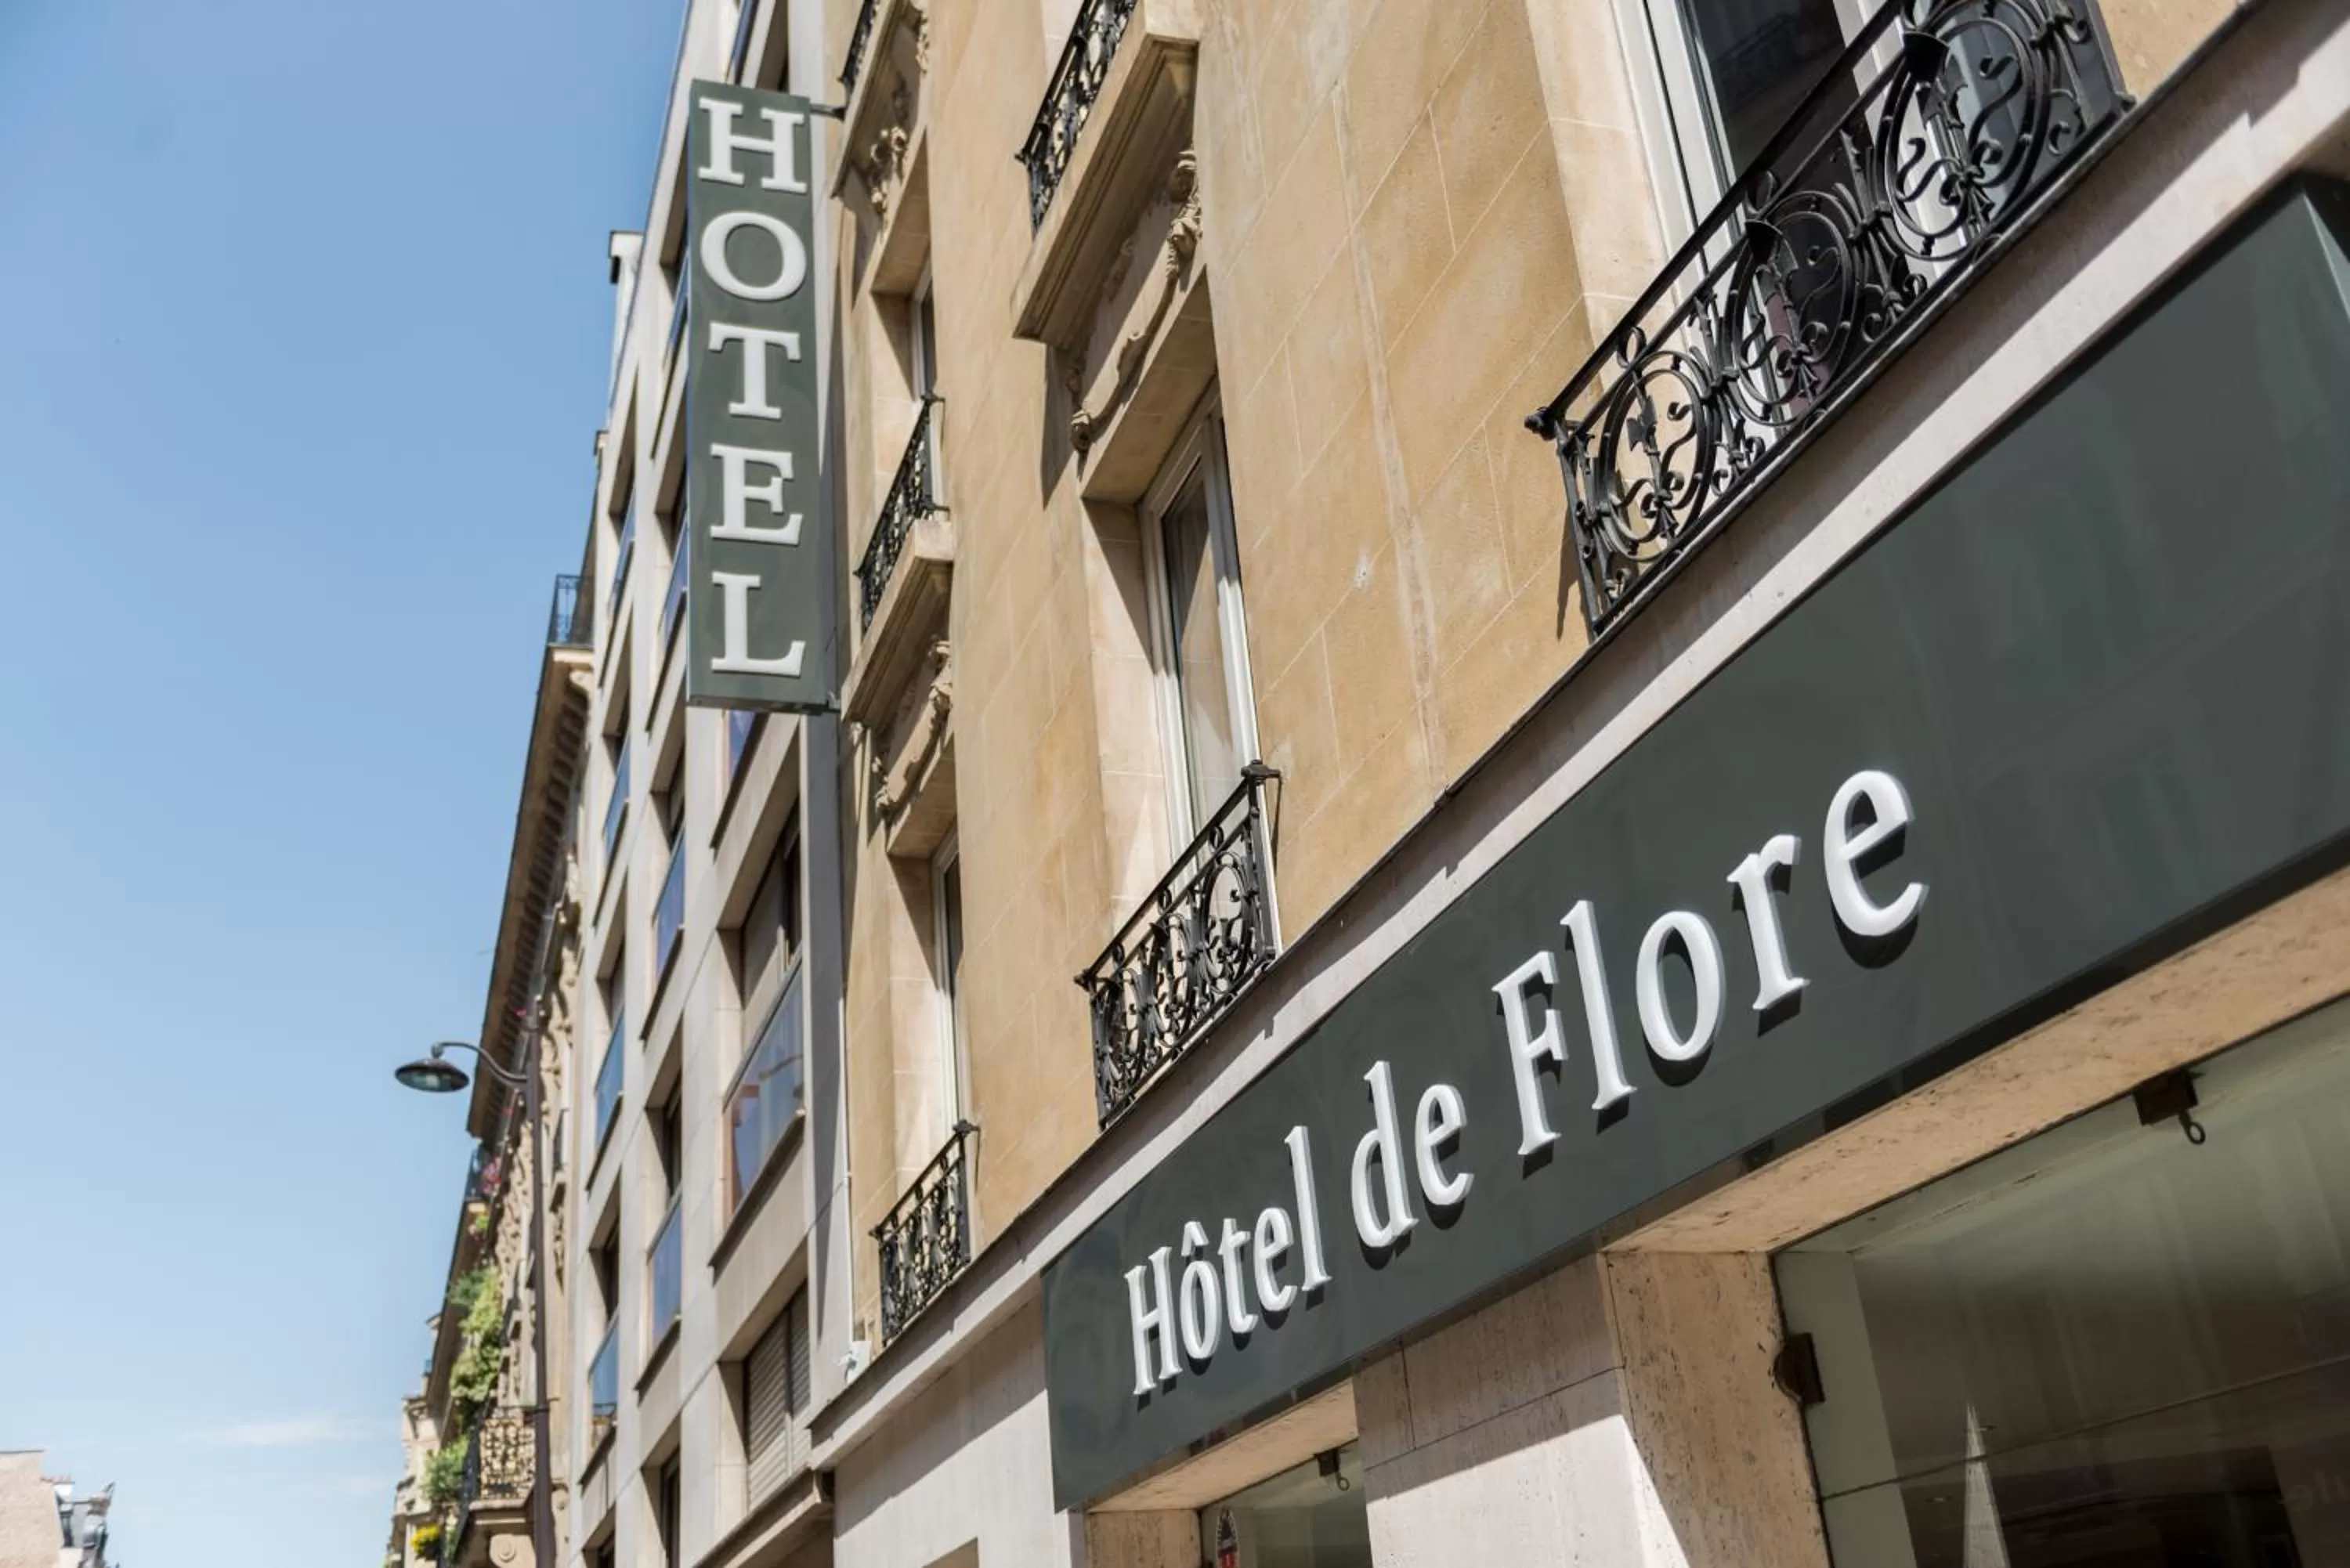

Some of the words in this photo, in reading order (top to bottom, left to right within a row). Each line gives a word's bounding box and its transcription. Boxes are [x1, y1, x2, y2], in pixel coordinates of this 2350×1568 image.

[697, 95, 808, 676] HOTEL
[1124, 1125, 1332, 1396] Hôtel
[1351, 1060, 1474, 1248] de
[1491, 769, 1929, 1156] Flore
